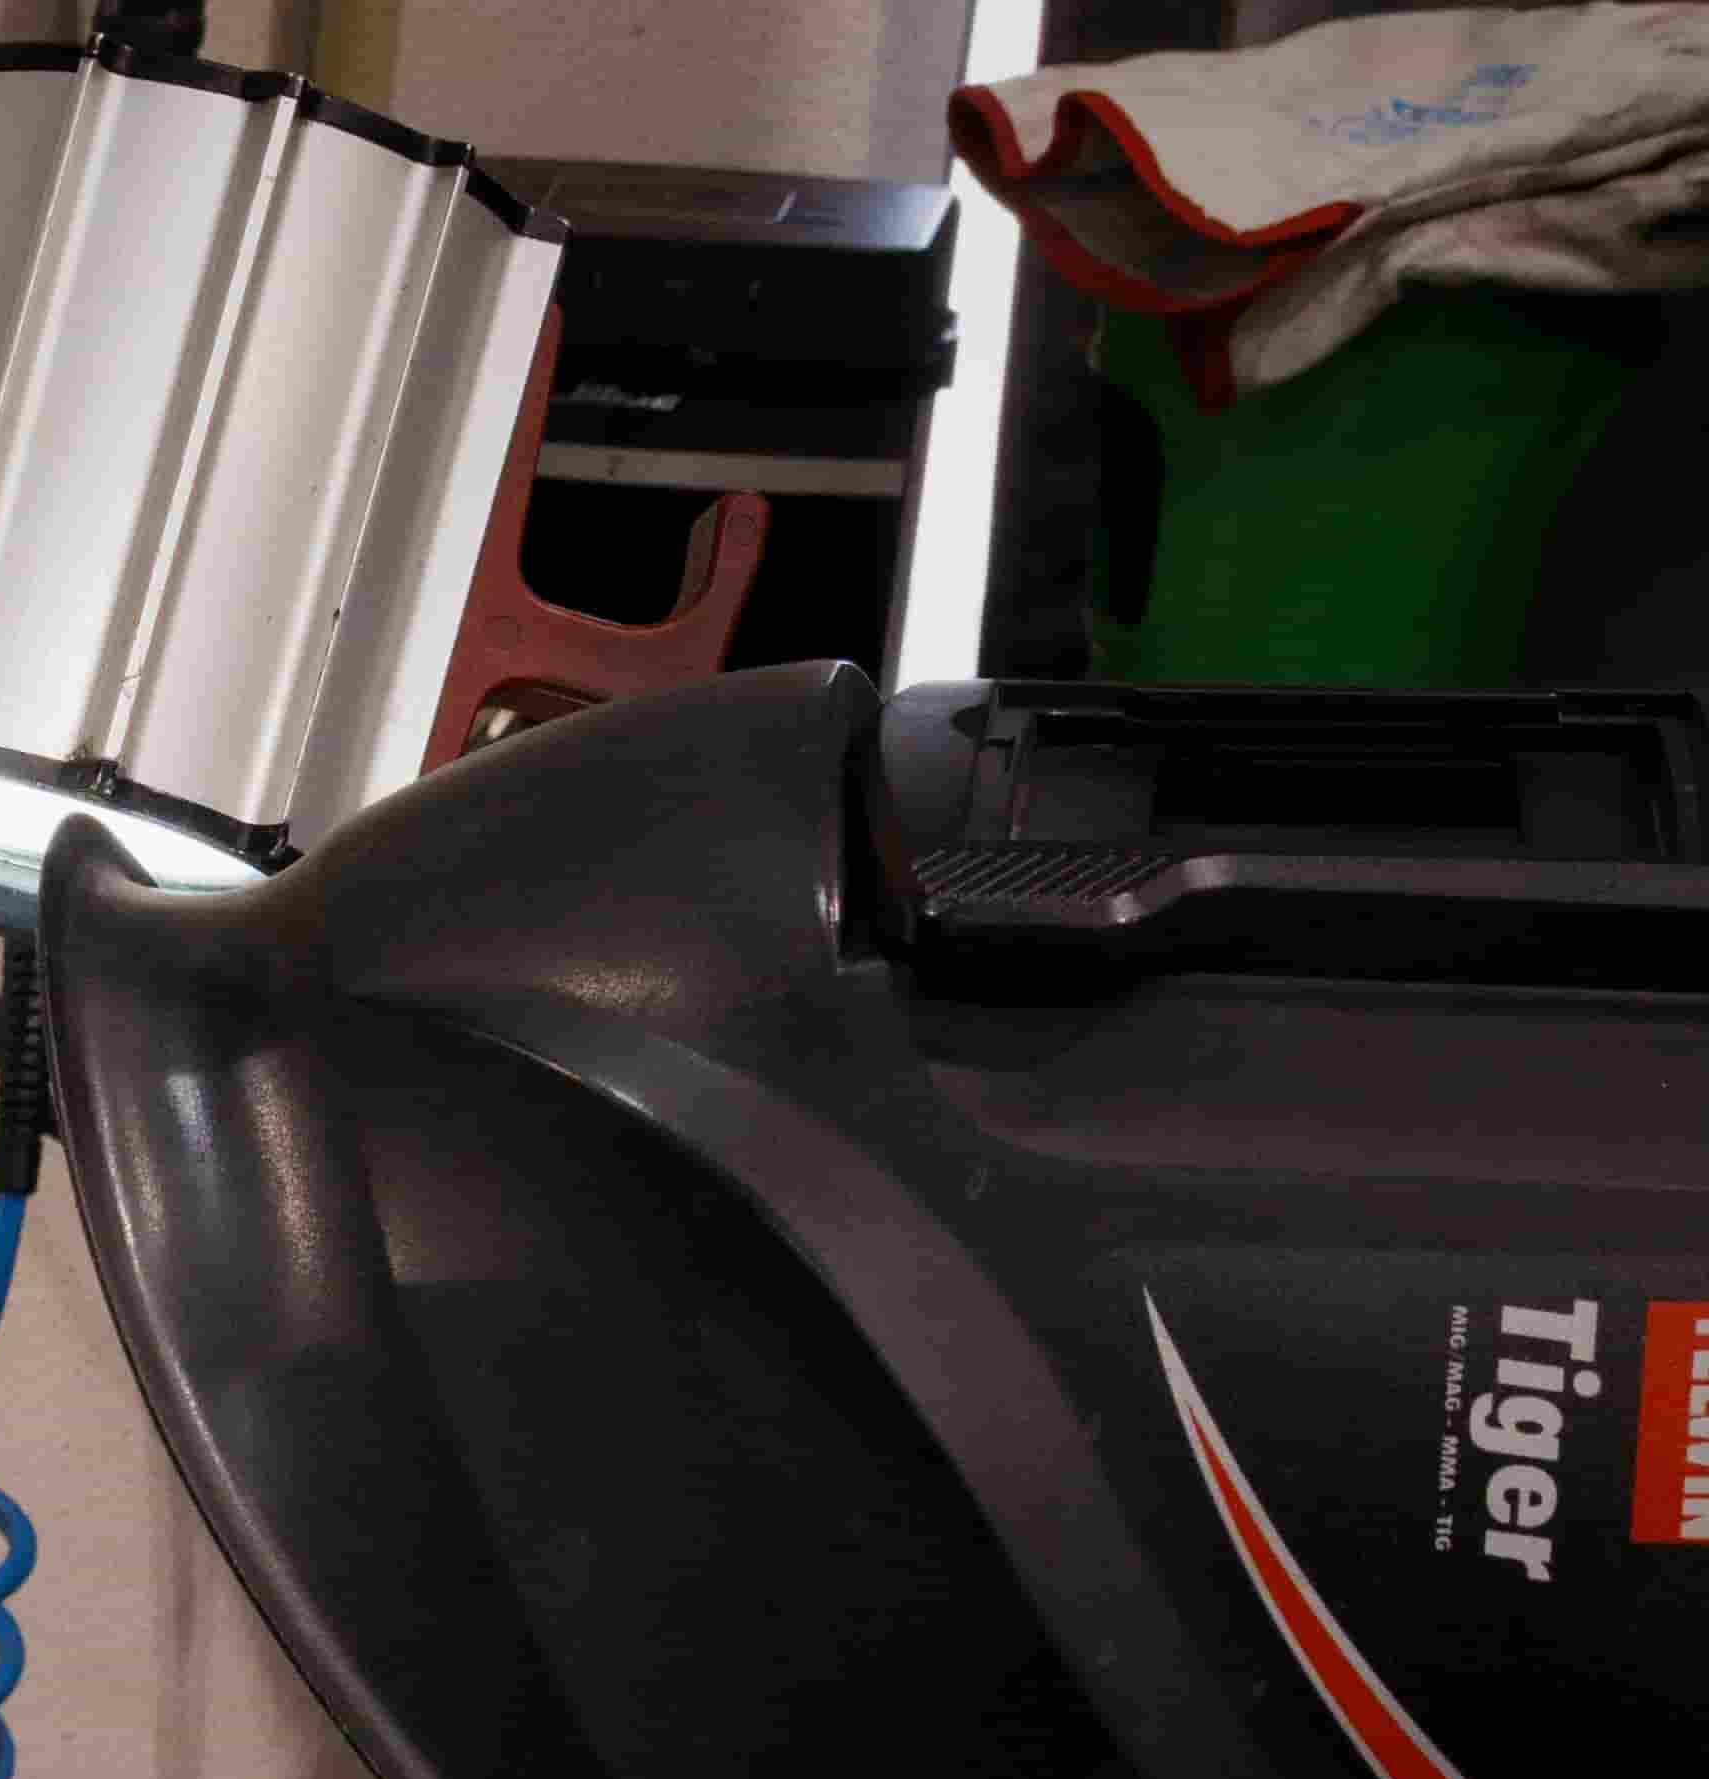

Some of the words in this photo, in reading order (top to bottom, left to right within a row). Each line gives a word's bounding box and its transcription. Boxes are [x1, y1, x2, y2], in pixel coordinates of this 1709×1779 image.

[1444, 1304, 1469, 1412] MIG/MAG
[1438, 1434, 1460, 1492] MMA
[1468, 1298, 1601, 1583] Tiger
[1434, 1513, 1454, 1552] TIG
